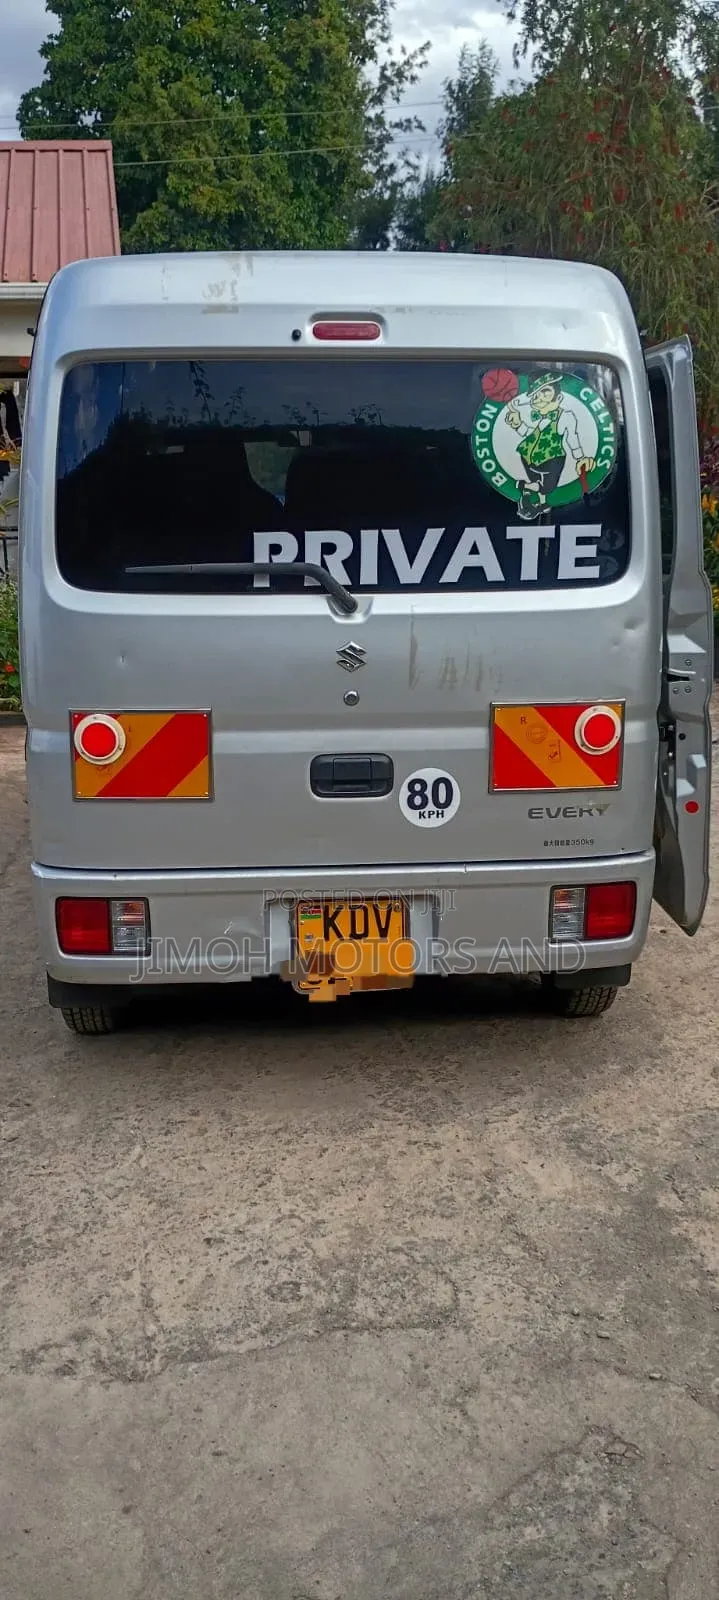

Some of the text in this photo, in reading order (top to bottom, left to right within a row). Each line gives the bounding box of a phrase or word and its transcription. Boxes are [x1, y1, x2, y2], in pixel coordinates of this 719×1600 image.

[475, 402, 508, 488] BOSTON
[579, 387, 615, 470] CELTICS
[253, 523, 602, 588] PRIVATE
[406, 776, 454, 811] 80
[527, 803, 612, 820] EVERY
[418, 809, 445, 820] KPH
[323, 903, 393, 942] KDV
